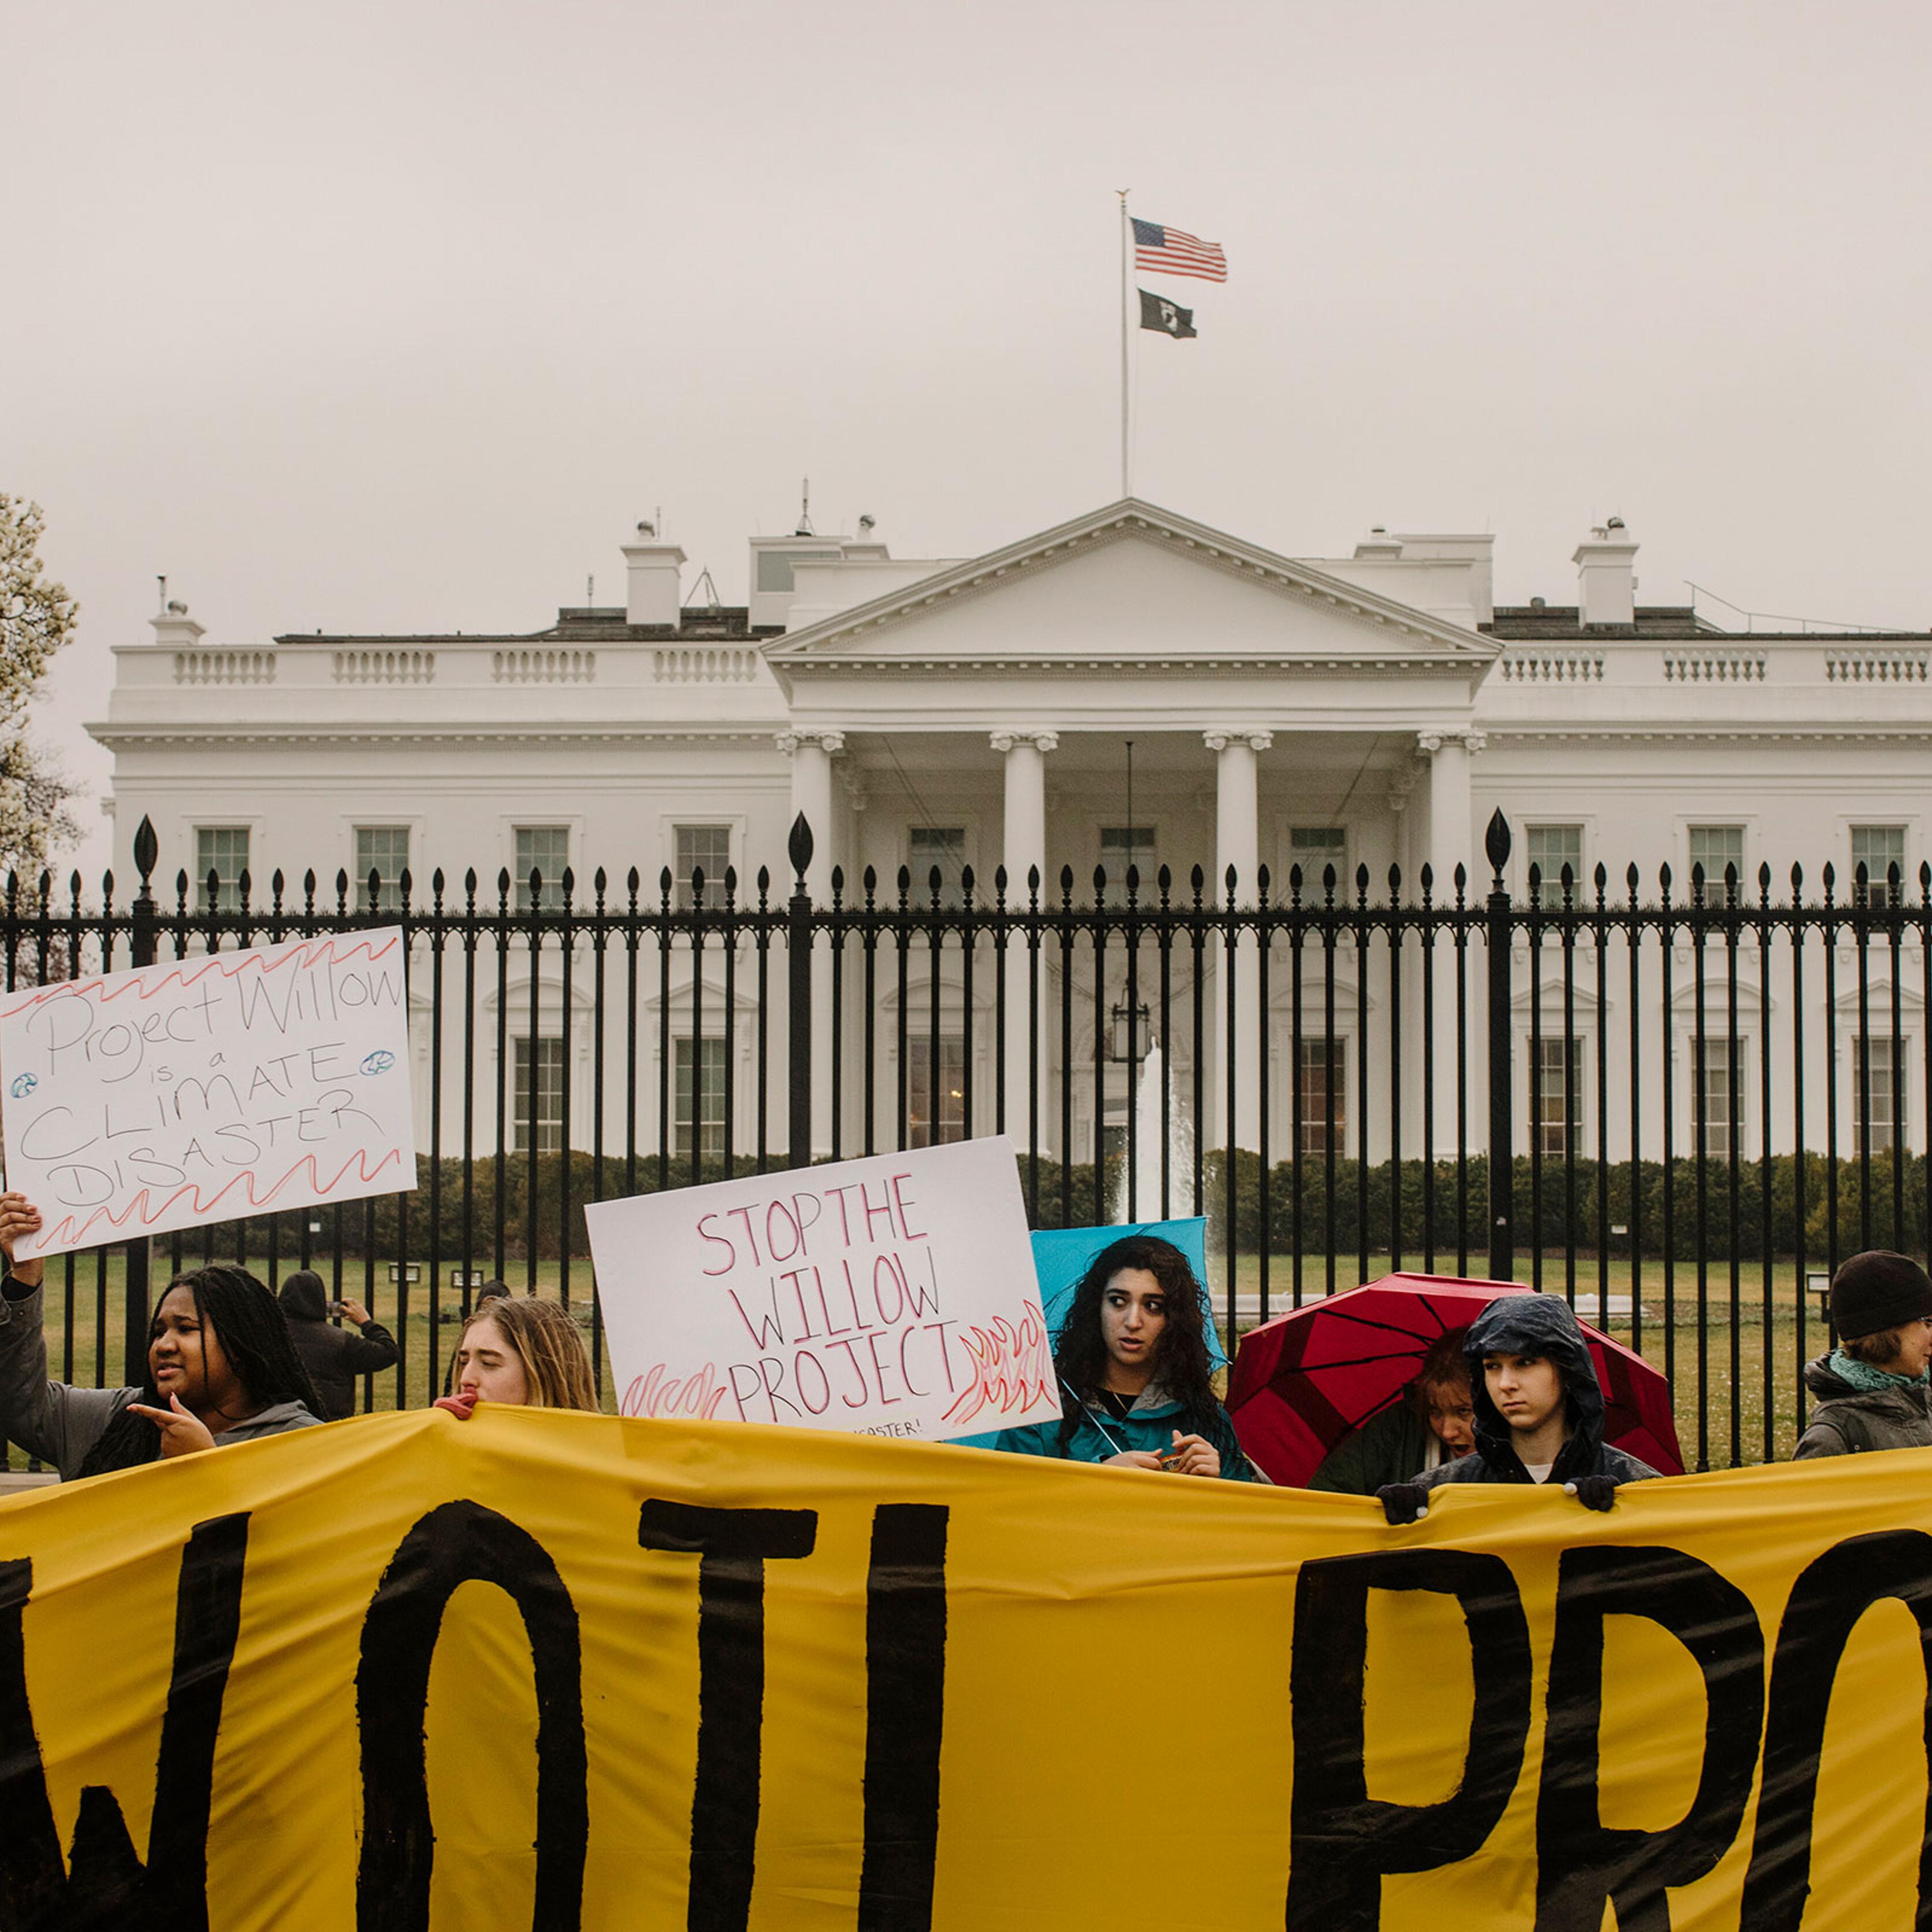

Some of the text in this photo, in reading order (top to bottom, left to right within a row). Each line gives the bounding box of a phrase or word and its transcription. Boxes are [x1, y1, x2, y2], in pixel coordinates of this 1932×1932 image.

[27, 954, 402, 1083] Project Willow
[150, 1053, 226, 1084] is a
[47, 1089, 386, 1207] DISASTER
[697, 1173, 928, 1276] STOP THE
[728, 1246, 939, 1350] WILLOW
[729, 1320, 958, 1423] PROJECT
[853, 1418, 923, 1438] ASTER!
